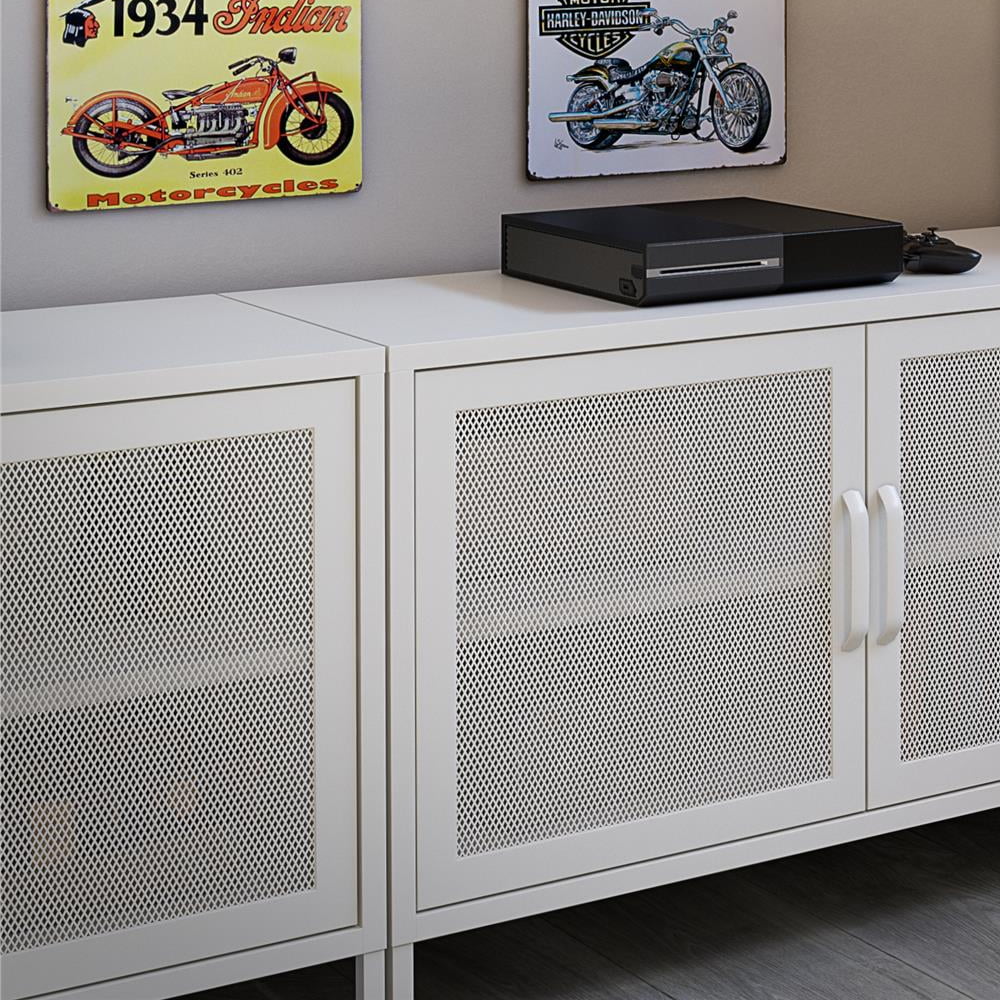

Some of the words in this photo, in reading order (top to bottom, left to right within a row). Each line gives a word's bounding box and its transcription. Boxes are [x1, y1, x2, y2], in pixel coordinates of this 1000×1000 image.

[546, 8, 644, 29] HARLEY-DAVIDSON
[569, 32, 621, 53] CYCLES
[189, 170, 219, 179] Series
[222, 167, 243, 176] 402
[86, 177, 340, 208] Motorcycles
